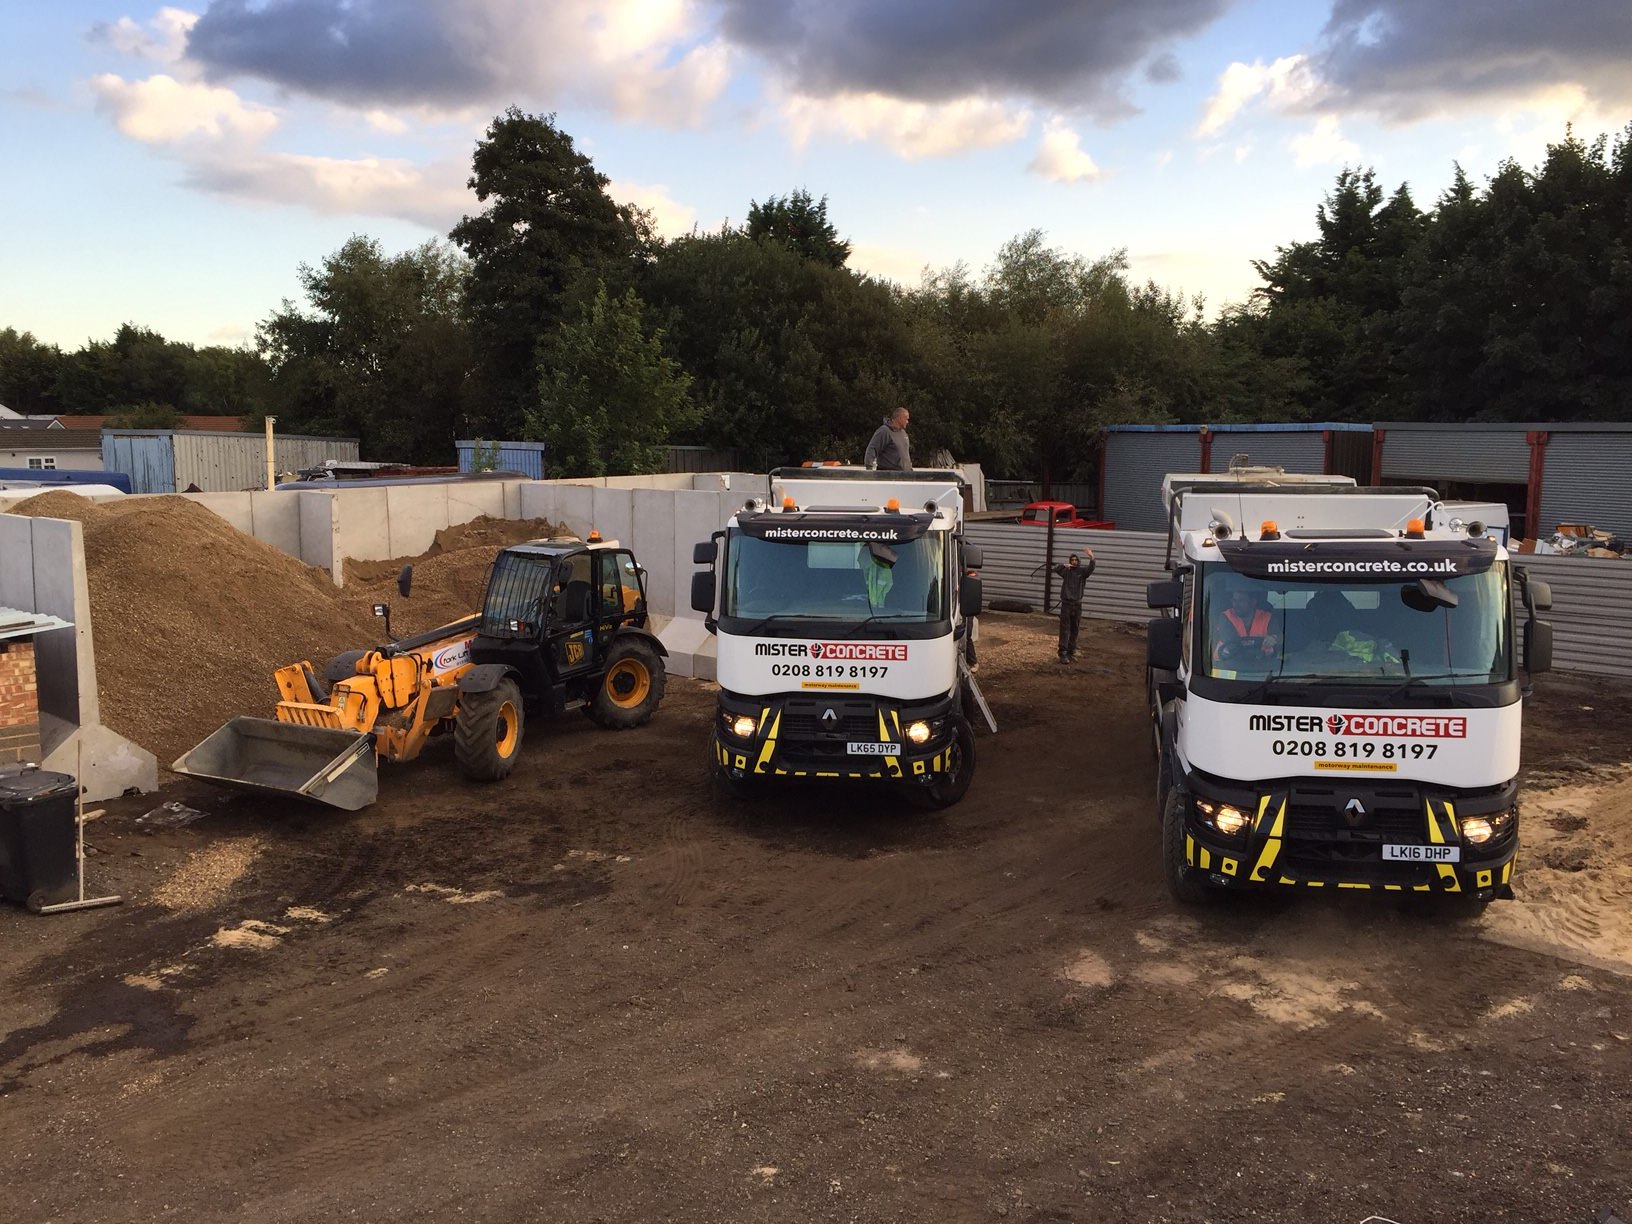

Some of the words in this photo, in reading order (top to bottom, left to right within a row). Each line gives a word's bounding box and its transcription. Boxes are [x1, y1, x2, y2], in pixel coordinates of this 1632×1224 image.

[765, 527, 898, 540] misterconcrete.co.uk
[1267, 559, 1457, 573] misterconcrete.co.uk
[567, 643, 583, 663] JCB
[755, 643, 808, 657] MISTER
[826, 644, 906, 660] CONCRETE
[772, 664, 811, 677] 0208
[815, 665, 844, 677] 819
[849, 666, 888, 678] 8197
[1249, 714, 1323, 732] MISTER
[1351, 716, 1464, 736] CONCRETE
[850, 743, 876, 753] LK65
[877, 744, 897, 754] DYP
[1272, 740, 1327, 756] 0208
[1334, 742, 1376, 758] 819
[1382, 744, 1438, 760] 8197
[1390, 846, 1420, 859] LK16
[1425, 847, 1451, 860] DHP
